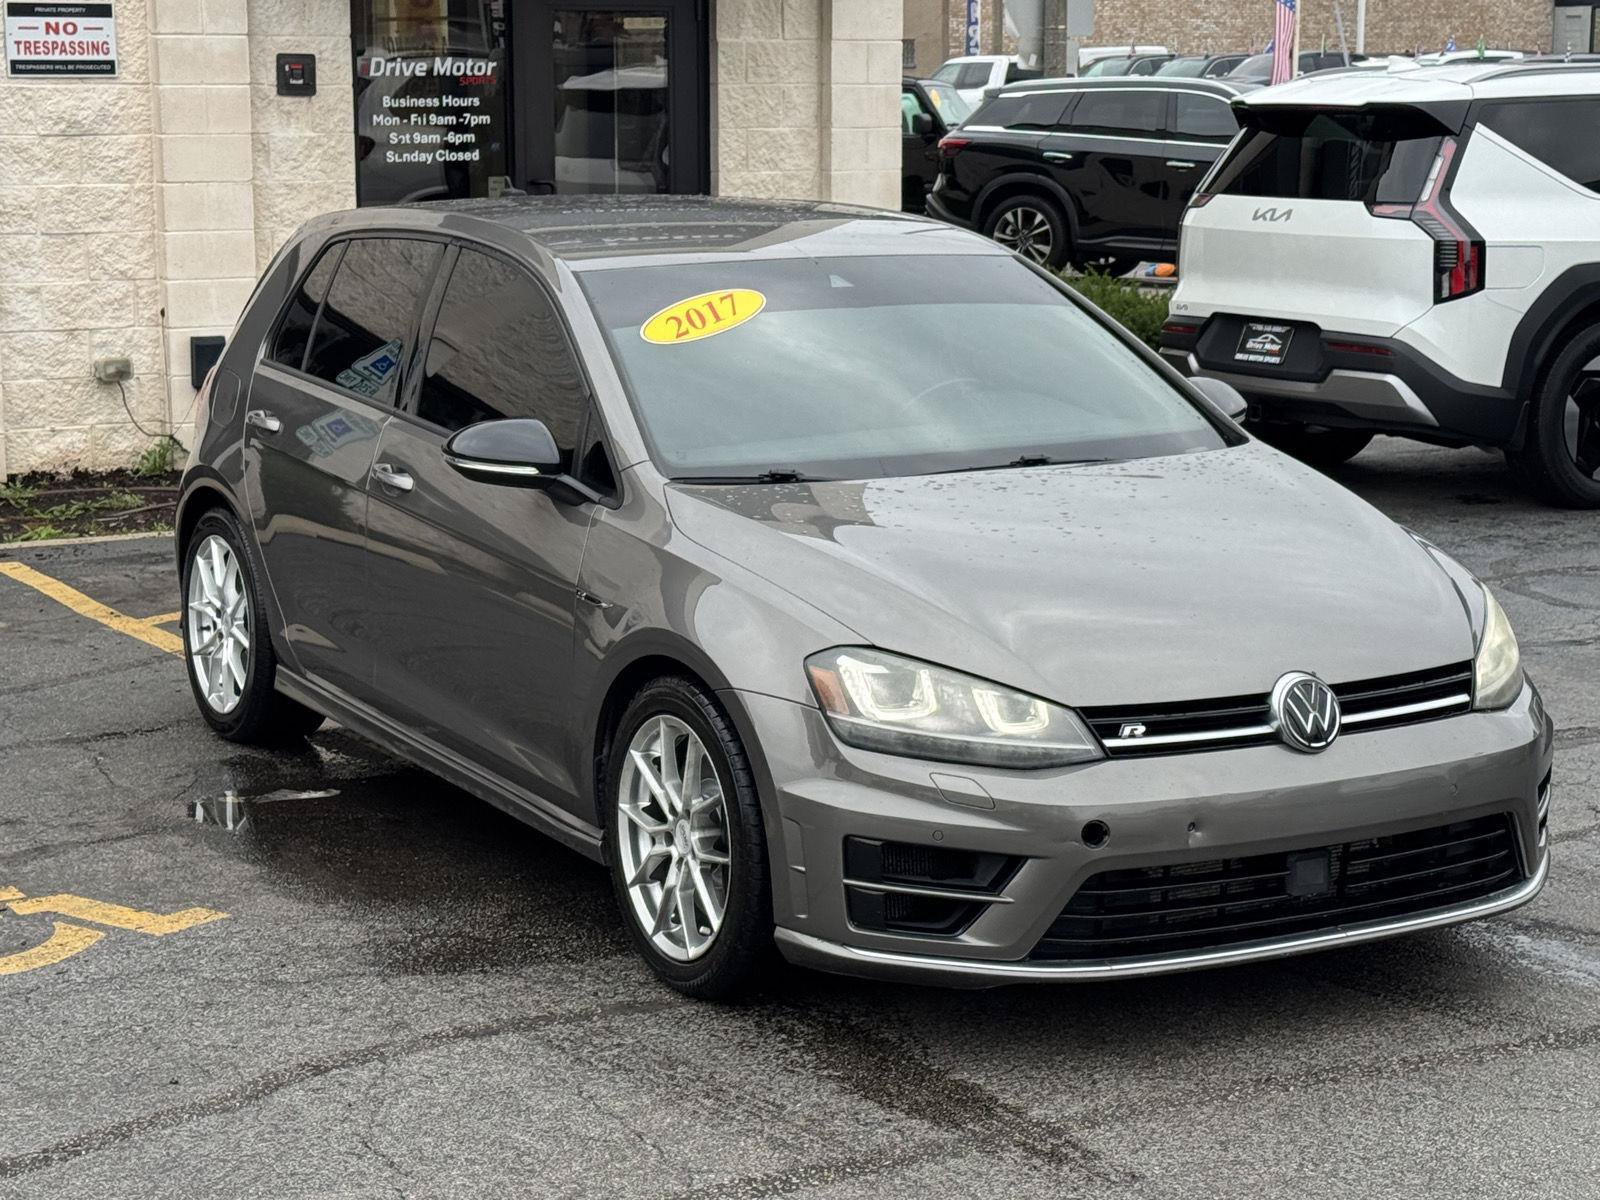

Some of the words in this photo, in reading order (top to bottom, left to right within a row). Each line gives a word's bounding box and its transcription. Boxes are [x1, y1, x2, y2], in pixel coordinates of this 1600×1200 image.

[44, 22, 78, 35] NO
[14, 40, 110, 56] TRESPASSING
[433, 57, 497, 77] Motor
[382, 95, 440, 108] Business
[442, 95, 480, 107] Hours
[372, 114, 400, 126] Mon
[429, 113, 457, 126] 9am
[412, 132, 440, 144] 9am
[435, 149, 480, 162] Closed
[1252, 207, 1293, 222] KIA
[665, 293, 737, 339] 2017
[1119, 722, 1147, 739] R
